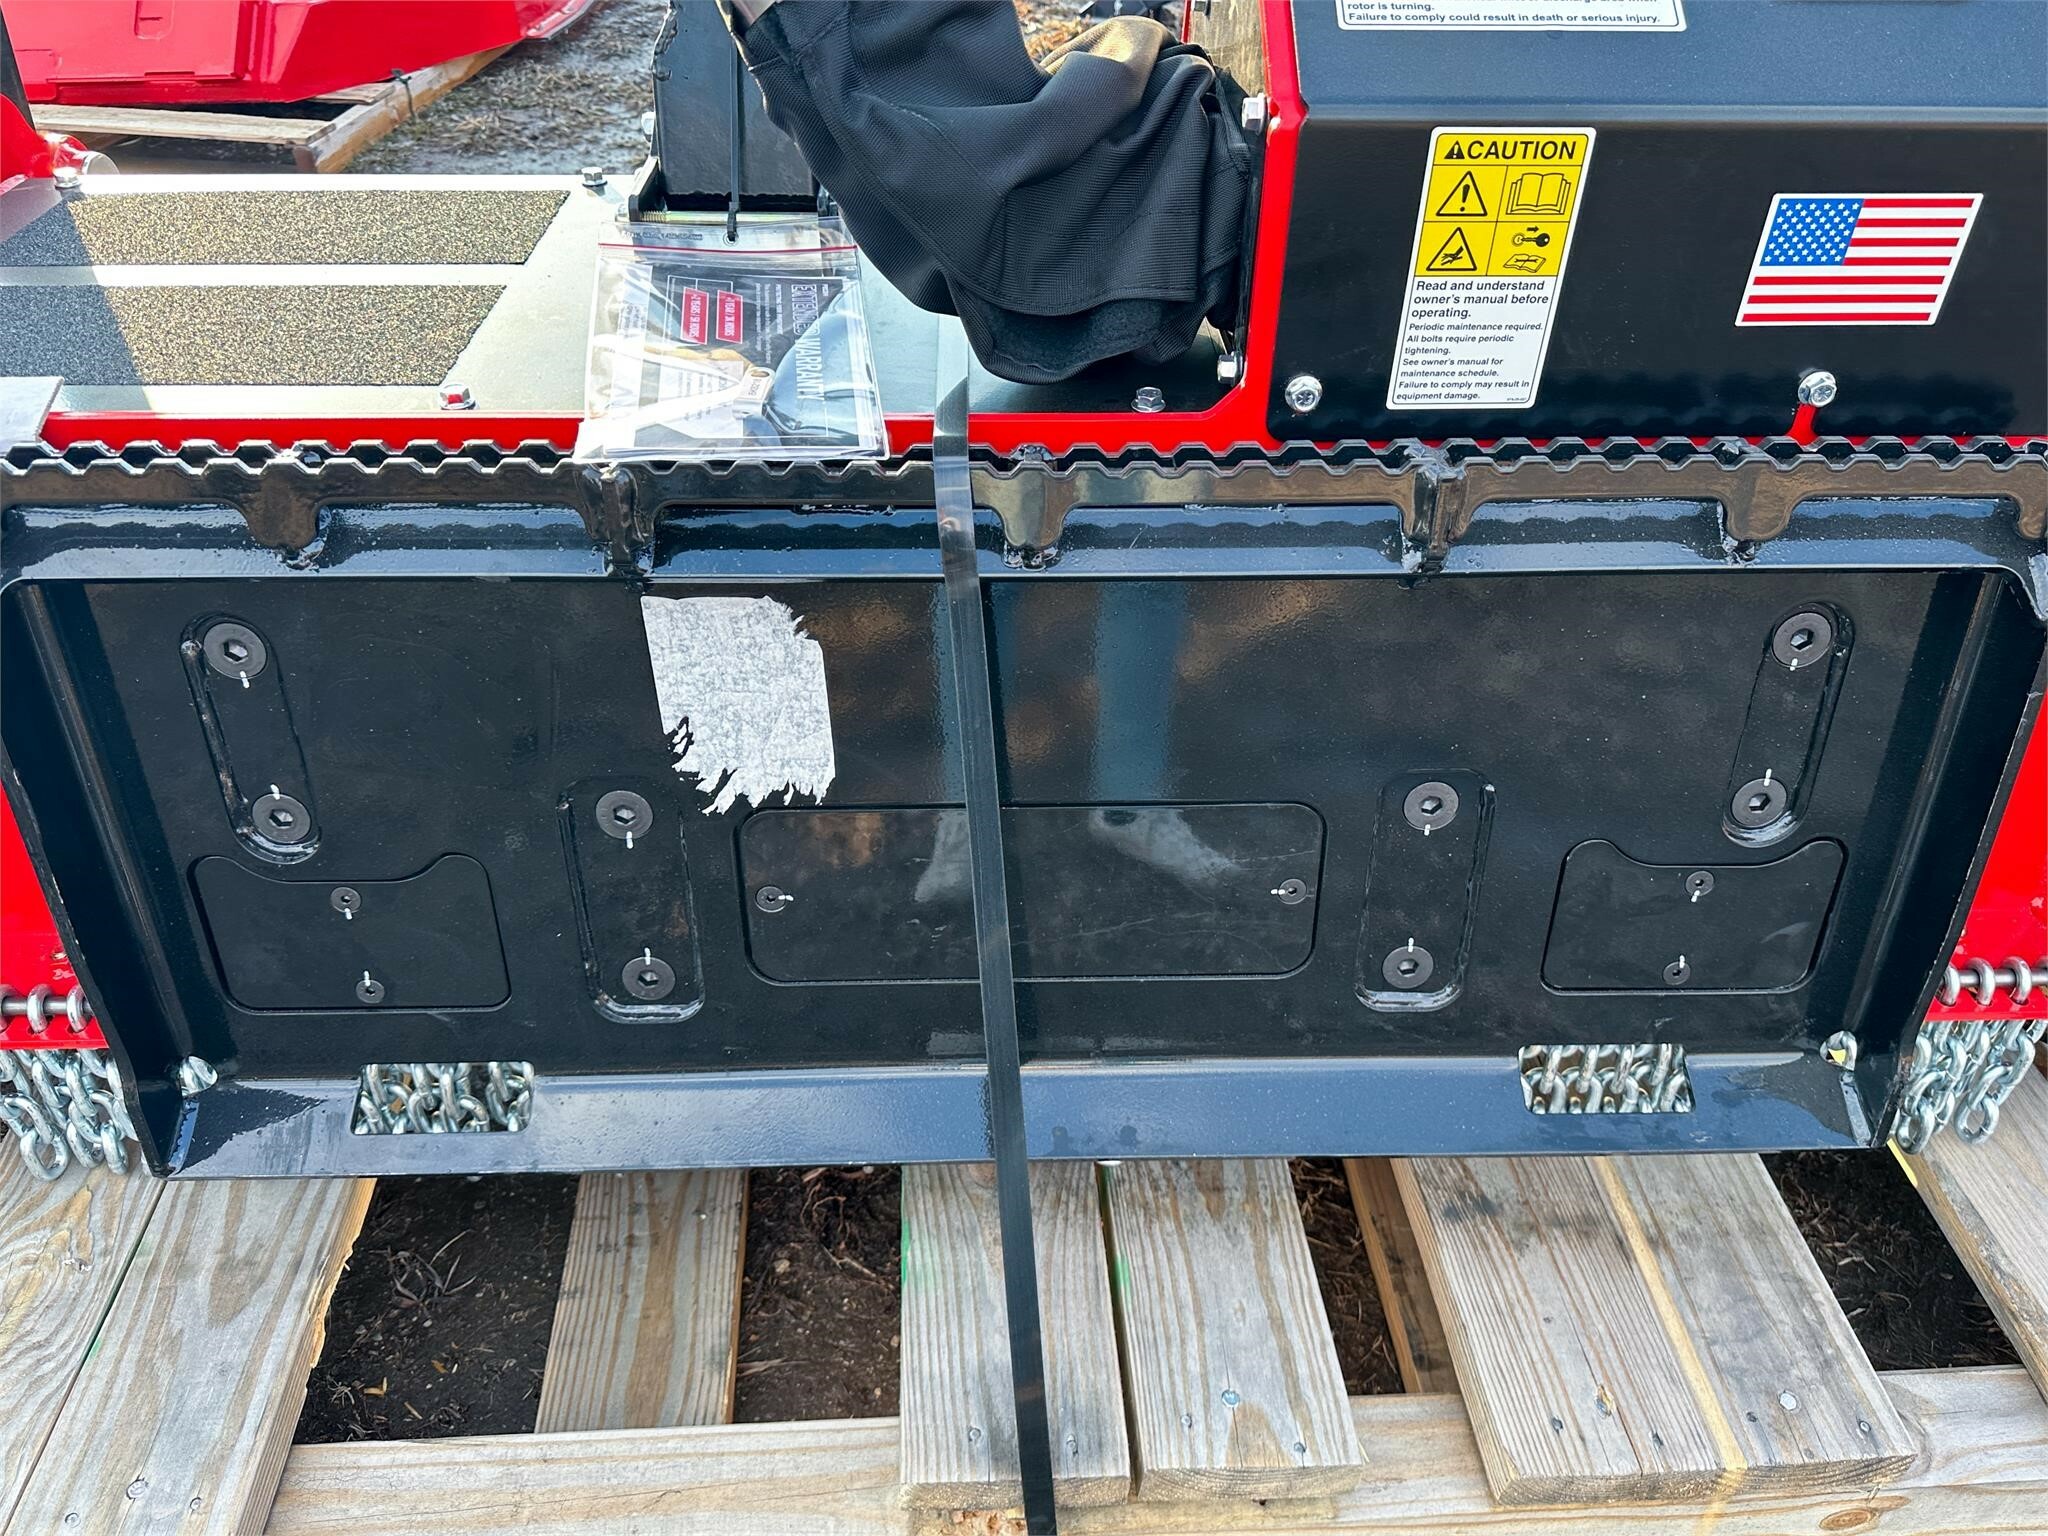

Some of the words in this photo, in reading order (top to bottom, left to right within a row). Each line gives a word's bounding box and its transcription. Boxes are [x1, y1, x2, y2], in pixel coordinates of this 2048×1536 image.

[1348, 2, 1375, 10] rotor
[1378, 2, 1387, 10] is
[1391, 2, 1435, 12] turning.
[1349, 13, 1387, 21] Failure
[1390, 13, 1401, 21] to
[1405, 13, 1445, 23] comply
[1449, 13, 1480, 22] could
[1484, 13, 1516, 22] result
[1519, 13, 1529, 22] in
[1532, 13, 1564, 22] death
[1582, 14, 1622, 22] serious
[1626, 14, 1660, 24] injury.
[1467, 140, 1576, 159] CAUTION
[1417, 281, 1447, 290] Read
[1450, 281, 1473, 290] and
[1477, 281, 1545, 290] understand
[1414, 295, 1460, 304] owner's
[1464, 295, 1508, 304] manual
[1511, 295, 1548, 304] before
[690, 300, 701, 313] YEARS
[725, 303, 735, 313] YEAR
[791, 284, 820, 336] EXTENDED
[1411, 308, 1471, 319] operating.
[689, 323, 700, 337] HOURS
[725, 322, 734, 336] HOURS
[1505, 324, 1543, 332] required.
[1445, 335, 1476, 343] require
[1478, 335, 1514, 343] periodic
[1405, 347, 1451, 355] tightening.
[795, 338, 824, 401] WARRANTY
[1441, 381, 1472, 389] comply
[1397, 392, 1441, 400] equipment
[1444, 392, 1480, 400] damage.
